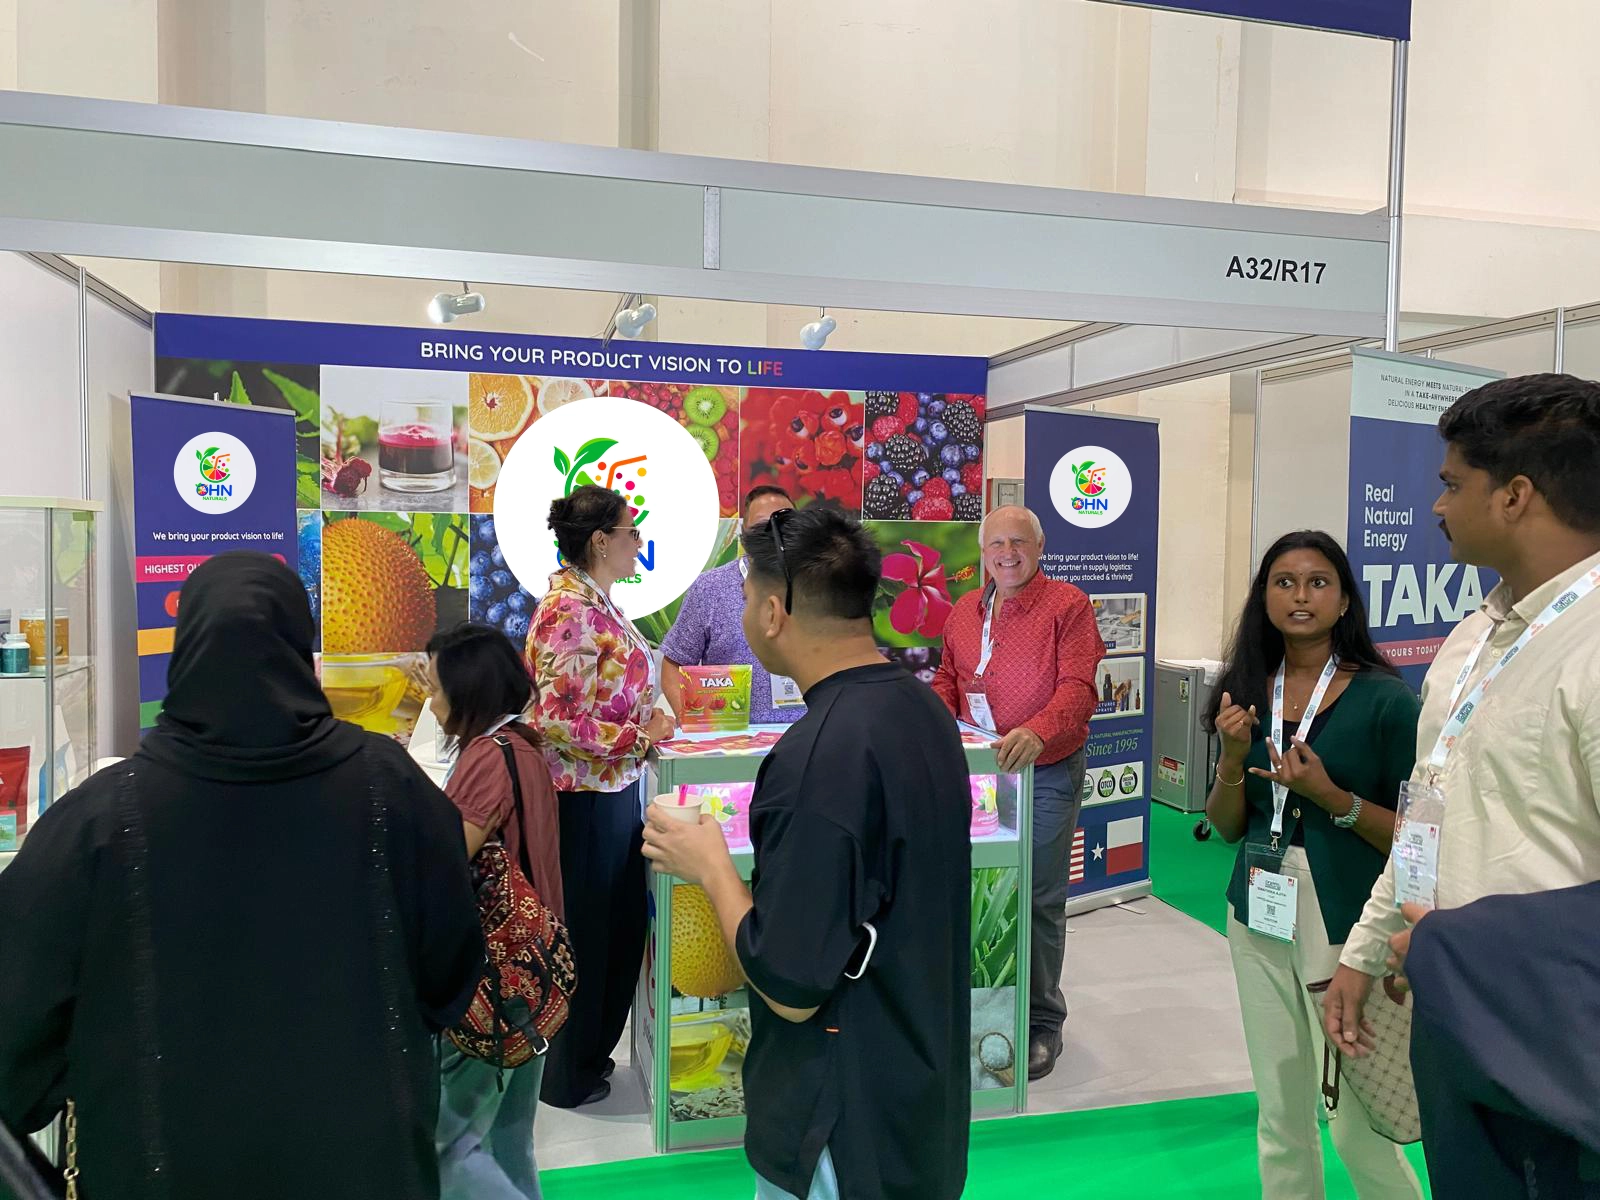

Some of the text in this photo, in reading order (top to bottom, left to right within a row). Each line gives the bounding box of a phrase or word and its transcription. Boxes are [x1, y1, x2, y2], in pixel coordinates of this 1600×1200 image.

[1226, 255, 1327, 285] A32/R17
[421, 341, 784, 377] BRING YOUR PRODUCT VISION TO LIFE
[1380, 374, 1404, 385] NATURAL
[1404, 377, 1425, 387] ENERGY
[1425, 381, 1442, 390] MEETS
[1442, 383, 1464, 393] NATURAL
[1387, 398, 1415, 409] DELICIOUS
[1415, 401, 1438, 412] HEALTHY
[195, 483, 233, 497] OHN
[1365, 483, 1394, 503] Real
[1071, 497, 1108, 510] OHN
[1364, 506, 1413, 526] Natural
[153, 531, 284, 542] We bring your product vision to life!
[1363, 529, 1408, 553] Energy
[1048, 553, 1064, 562] bring
[1065, 554, 1079, 562] your
[1081, 553, 1104, 562] product
[144, 563, 185, 574] HIGHEST
[1043, 563, 1057, 571] Your
[1058, 564, 1082, 573] partner
[1082, 563, 1088, 571] in
[1088, 564, 1109, 573] supply
[1052, 573, 1069, 583] keep
[1069, 574, 1081, 583] you
[1081, 573, 1105, 581] stocked
[1105, 573, 1111, 581] &
[1111, 573, 1134, 582] thriving!
[1363, 563, 1484, 628] TAKA
[1386, 647, 1413, 657] YOURS
[1416, 644, 1441, 656] TODAY!
[699, 677, 734, 688] TAKA
[1085, 737, 1139, 758] Since 1995
